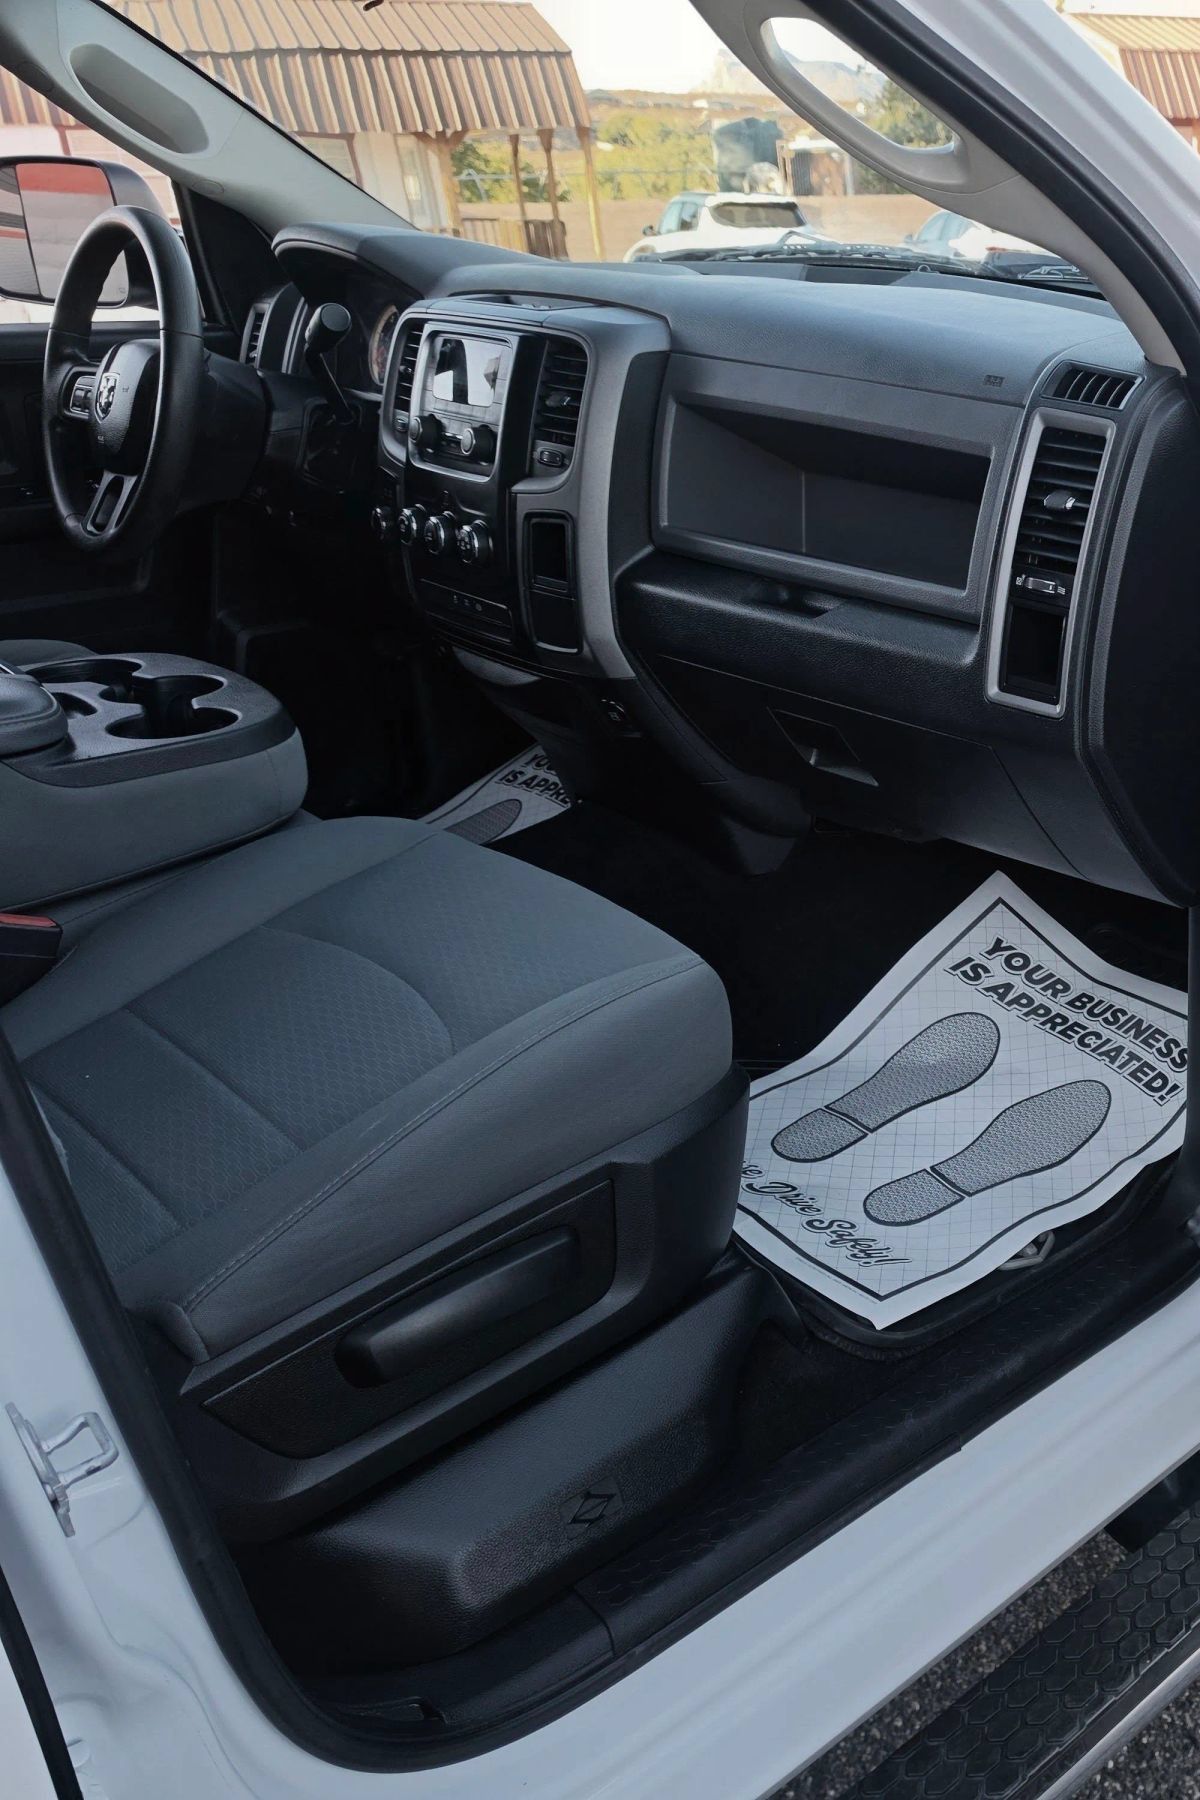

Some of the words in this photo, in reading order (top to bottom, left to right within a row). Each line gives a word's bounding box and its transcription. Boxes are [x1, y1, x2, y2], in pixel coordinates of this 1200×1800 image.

[499, 770, 525, 784] IS
[948, 956, 992, 983] IS
[980, 982, 1181, 1102] APPRECIATED!
[982, 936, 1072, 1000] YOUR
[1064, 992, 1188, 1072] BUSINESS
[745, 1181, 822, 1215] Drive
[804, 1218, 913, 1266] Safely!
